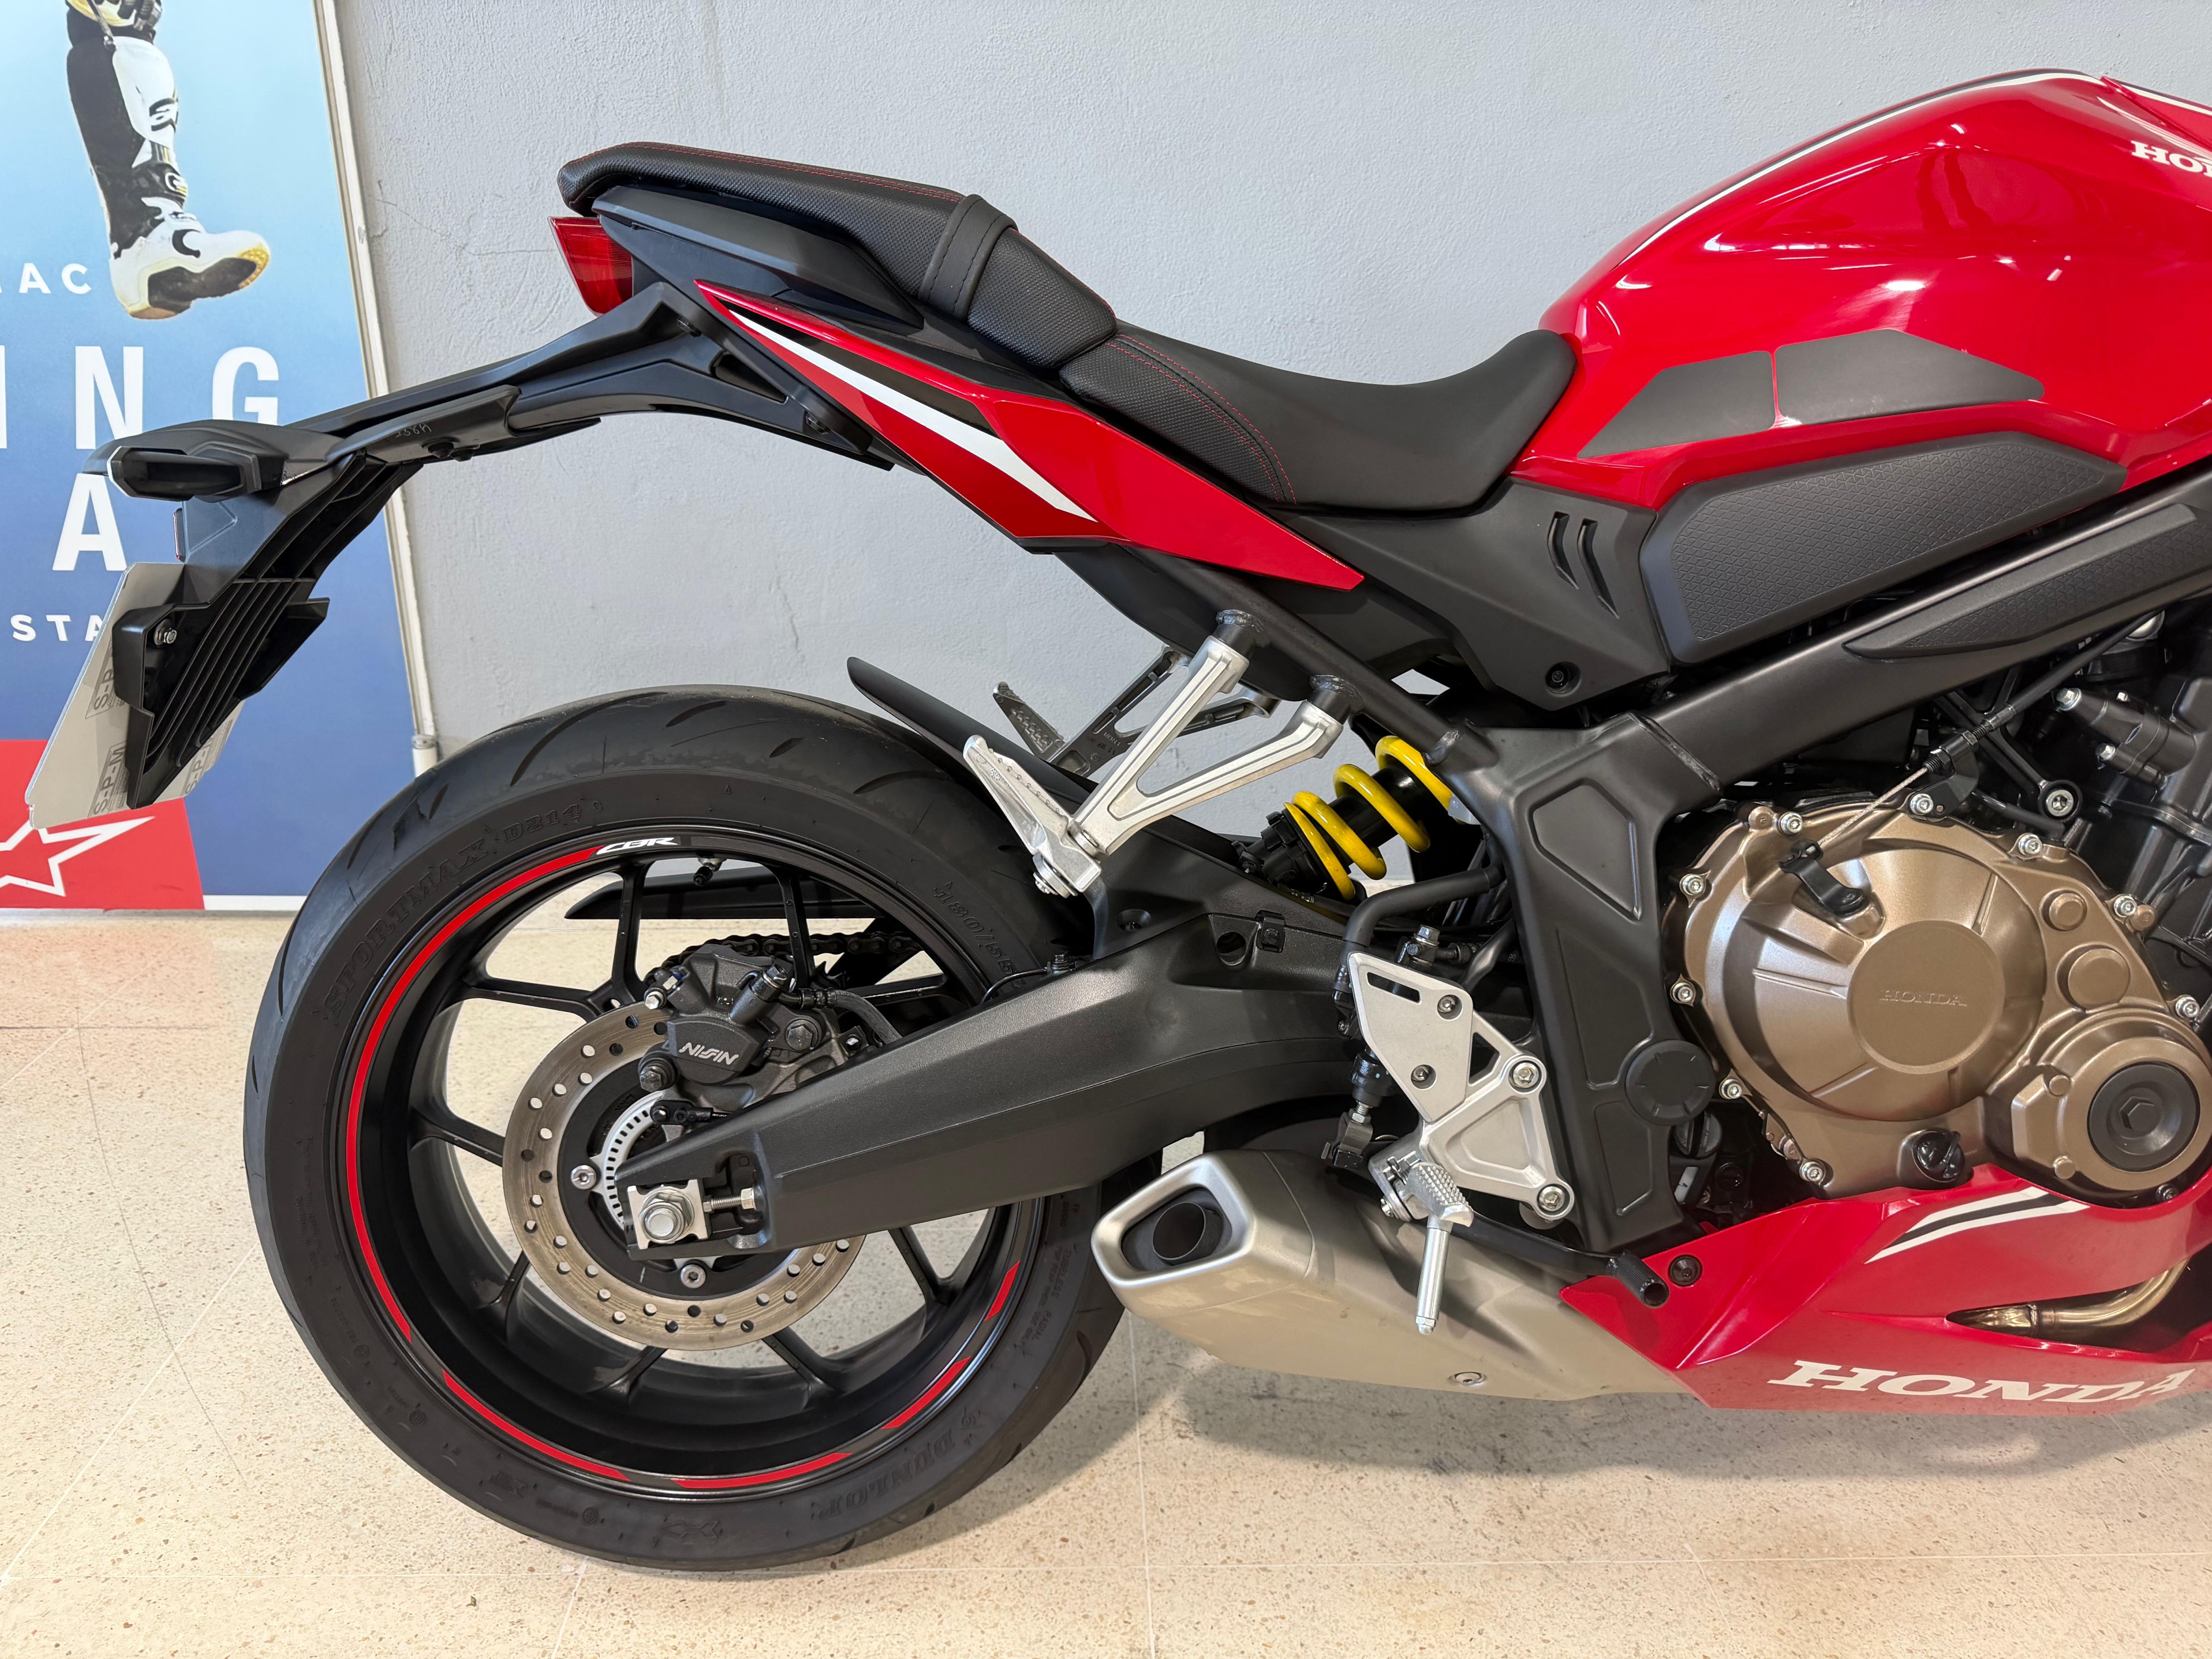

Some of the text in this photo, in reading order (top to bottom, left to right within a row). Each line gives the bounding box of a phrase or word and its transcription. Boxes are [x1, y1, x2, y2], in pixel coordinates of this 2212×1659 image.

[0, 263, 92, 294] AC
[52, 473, 127, 571] A
[596, 837, 678, 855] CBR
[324, 838, 489, 1014] SPORTMAX
[500, 803, 583, 843] D214
[1879, 989, 1967, 1007] HONDA
[679, 1042, 739, 1065] NISSIN
[1767, 1360, 2196, 1403] HONDA
[816, 1430, 957, 1519] DUNLOP
